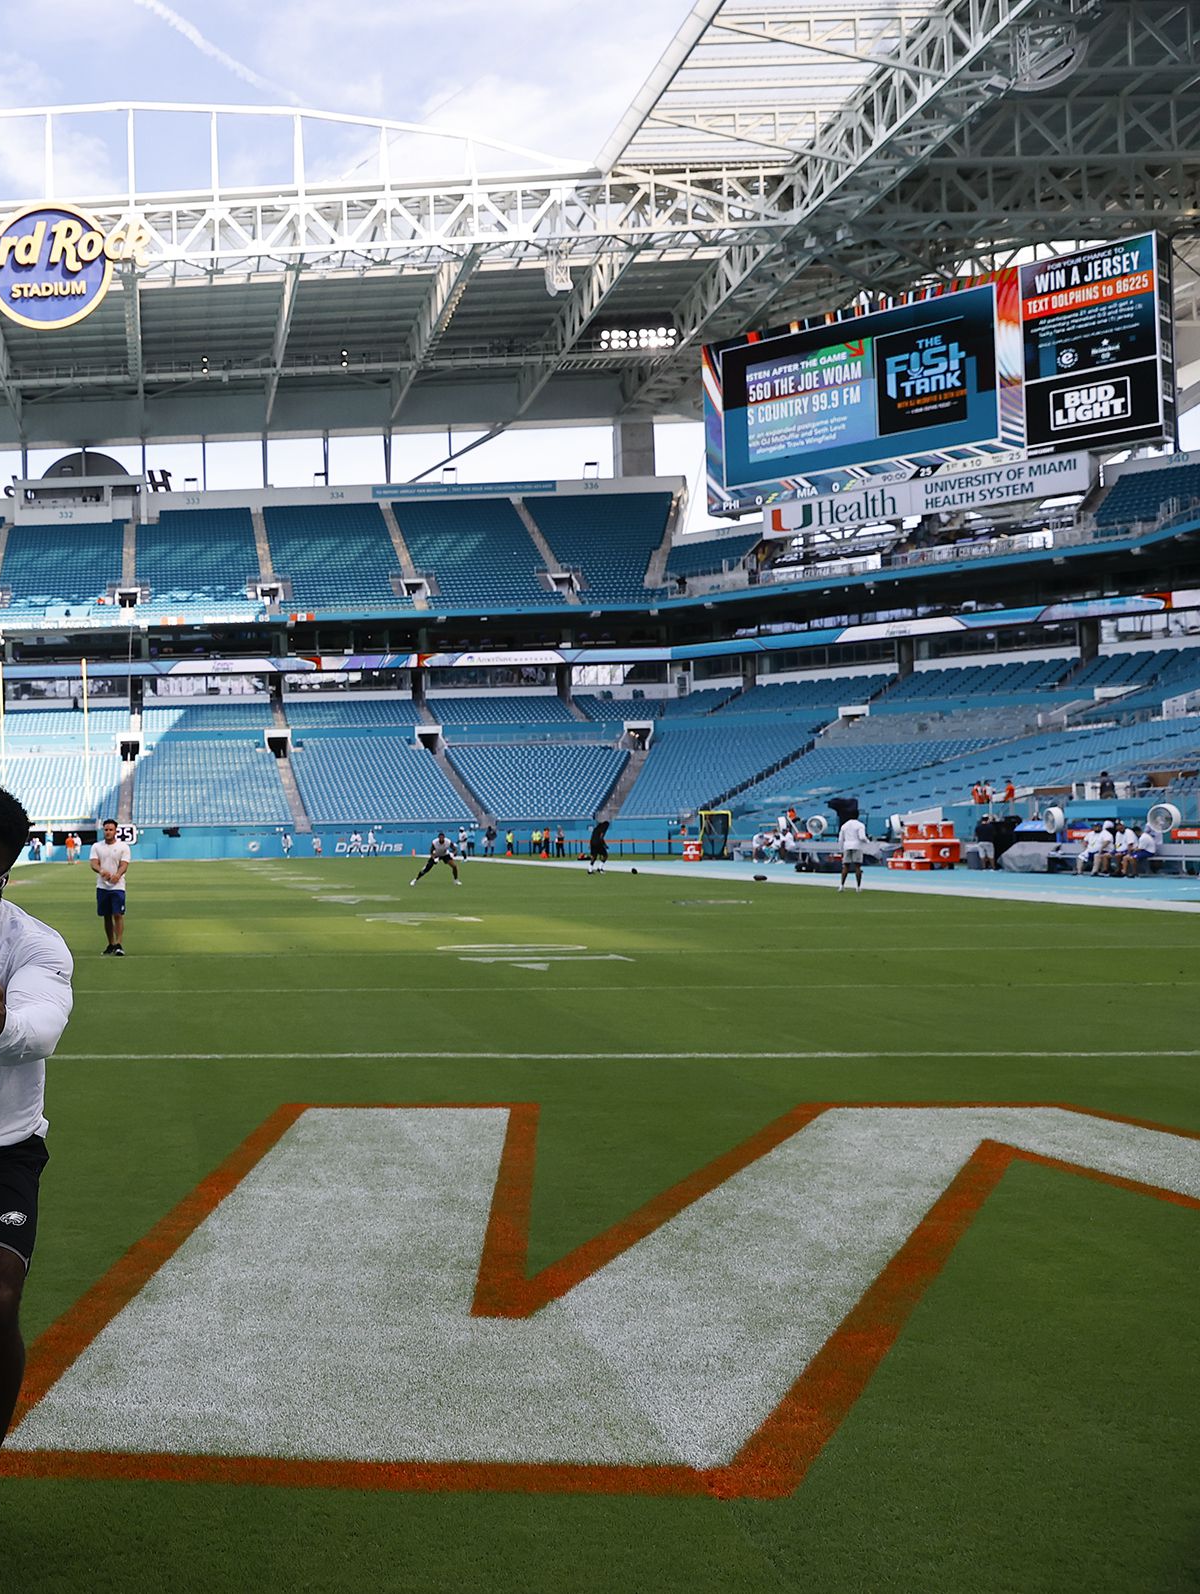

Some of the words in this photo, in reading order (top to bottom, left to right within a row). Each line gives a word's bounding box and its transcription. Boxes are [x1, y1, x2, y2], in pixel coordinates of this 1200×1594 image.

[49, 217, 151, 272] Rock
[1047, 262, 1061, 271] FOR
[1083, 249, 1113, 262] CHANCE
[1114, 246, 1125, 254] TO
[1035, 268, 1066, 294] WIN
[1070, 266, 1080, 286] A
[1084, 251, 1140, 282] JERSEY
[12, 281, 86, 299] STADIUM
[1027, 297, 1049, 314] TEXT
[1051, 285, 1099, 309] DOLPHINS
[1102, 284, 1113, 297] to
[1116, 273, 1149, 294] 86225
[916, 334, 942, 349] THE
[772, 363, 799, 376] AFTER
[800, 358, 818, 368] THE
[820, 352, 847, 364] GAME
[749, 382, 771, 402] 560
[774, 376, 795, 397] THE
[798, 370, 820, 392] JOE
[823, 361, 862, 386] WQAM
[900, 370, 961, 397] TANK
[758, 397, 810, 424] COUNTRY
[812, 390, 839, 412] 99.9
[843, 385, 860, 406] FM
[1064, 384, 1115, 409] BUD
[1055, 397, 1126, 426] LIGHT
[919, 467, 933, 477] 25
[1008, 452, 1021, 460] 25
[1167, 453, 1189, 465] 340
[584, 482, 599, 490] 336
[924, 471, 1003, 495] UNIVERSITY
[1006, 464, 1025, 480] OF
[1028, 458, 1077, 477] MIAMI
[186, 497, 200, 505] 333
[722, 500, 740, 511] PHI
[755, 495, 763, 505] 0
[797, 486, 818, 499] MIA
[832, 482, 840, 492] 0
[925, 490, 975, 510] HEALTH
[979, 481, 1034, 501] SYSTEM
[58, 511, 74, 519] 332
[716, 528, 731, 537] 337
[115, 827, 133, 842] 25
